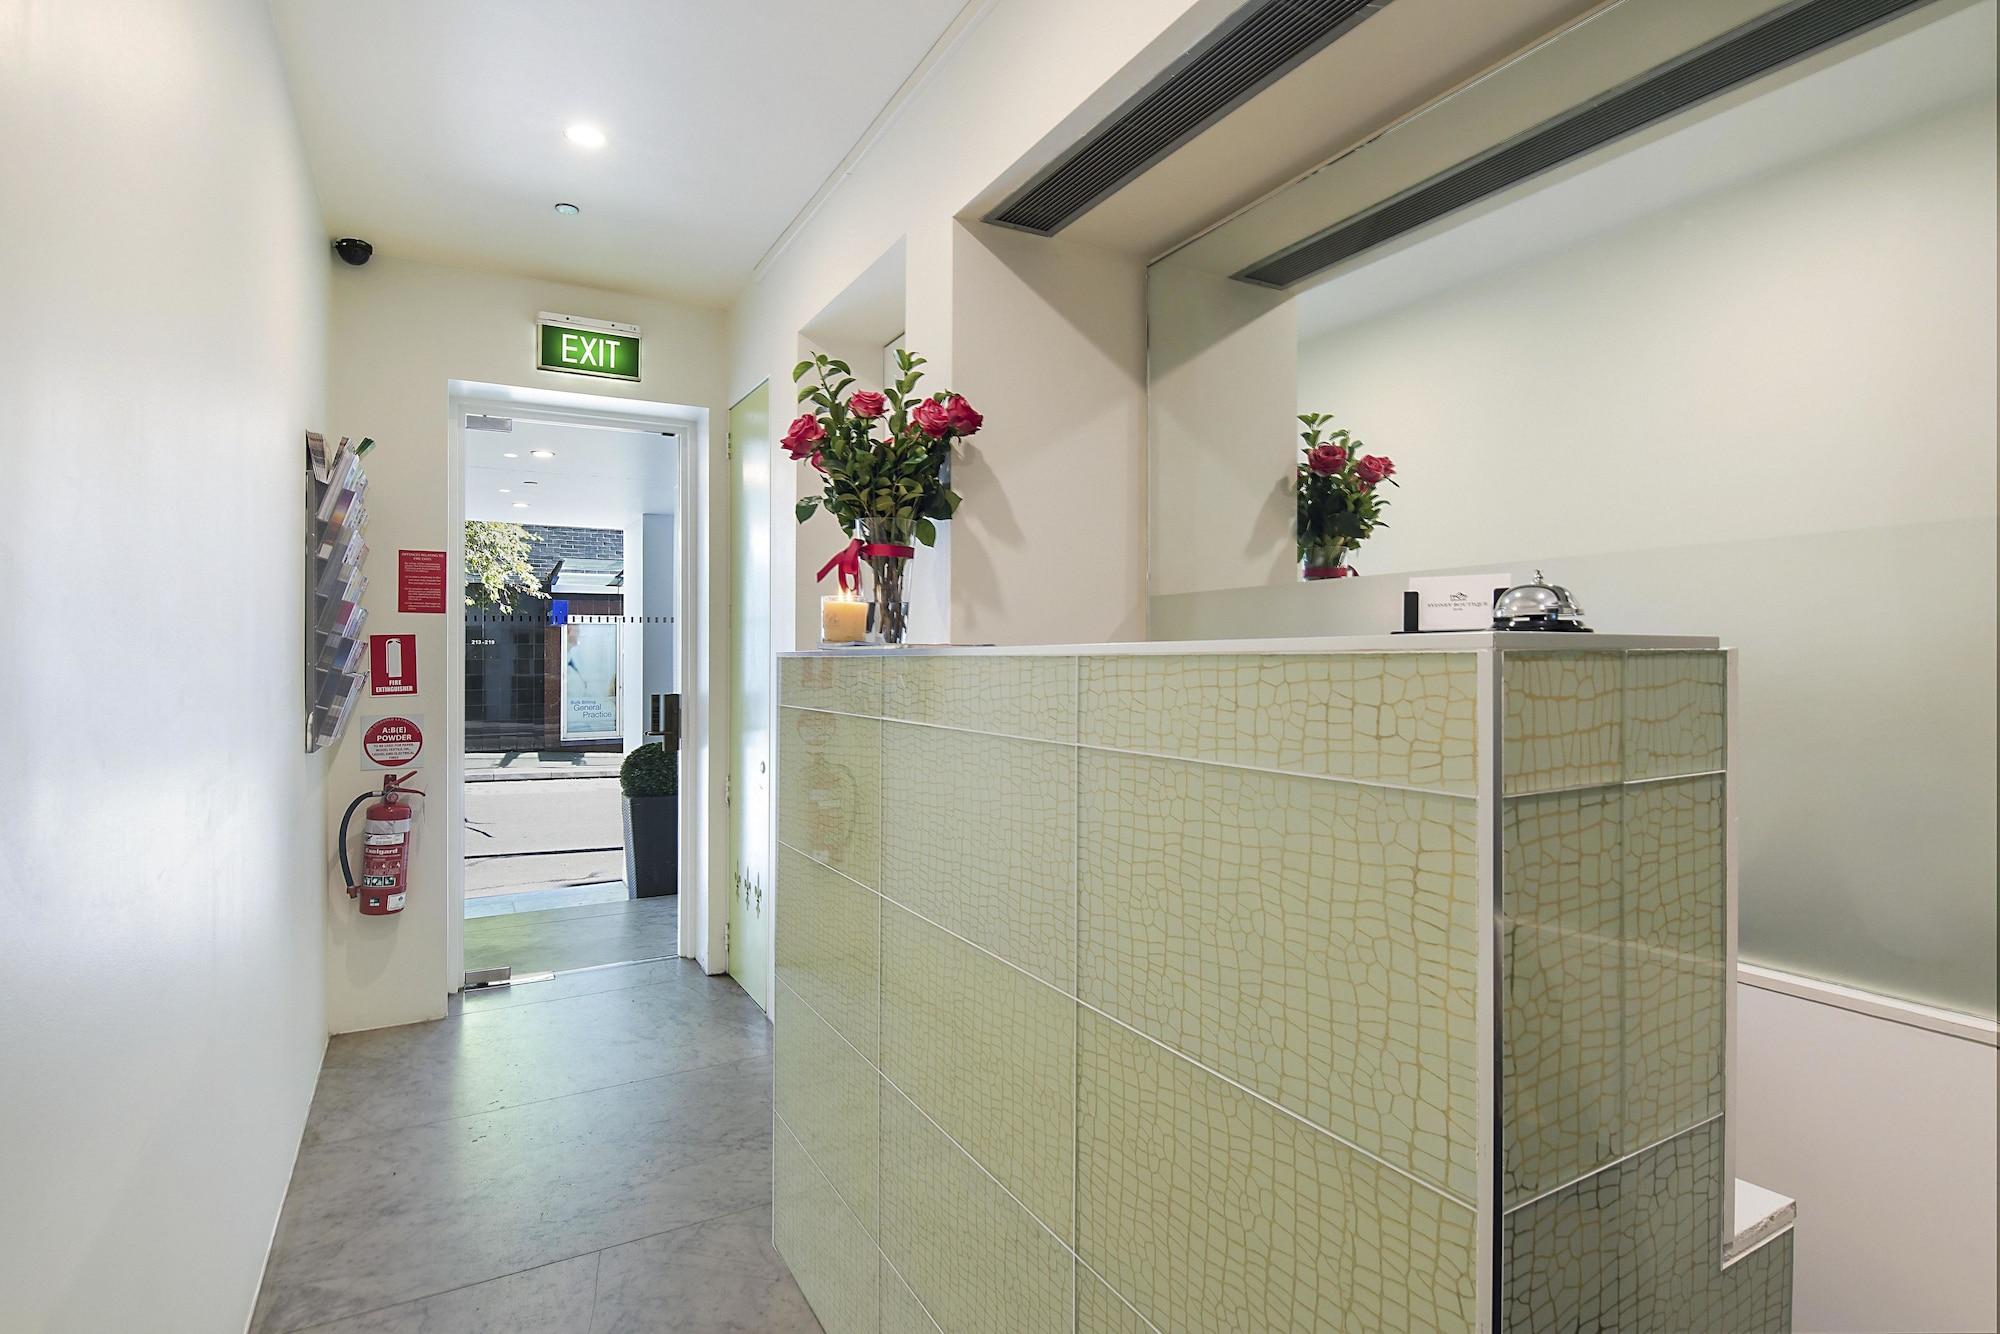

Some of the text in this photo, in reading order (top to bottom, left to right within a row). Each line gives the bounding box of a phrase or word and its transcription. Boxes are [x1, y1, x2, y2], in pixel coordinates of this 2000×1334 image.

[562, 333, 620, 368] EXIT
[375, 685, 413, 693] EXTINGUISHER
[573, 703, 602, 711] General
[582, 711, 613, 719] Practice
[382, 726, 407, 734] A:B(E)
[376, 734, 412, 742] POWDER
